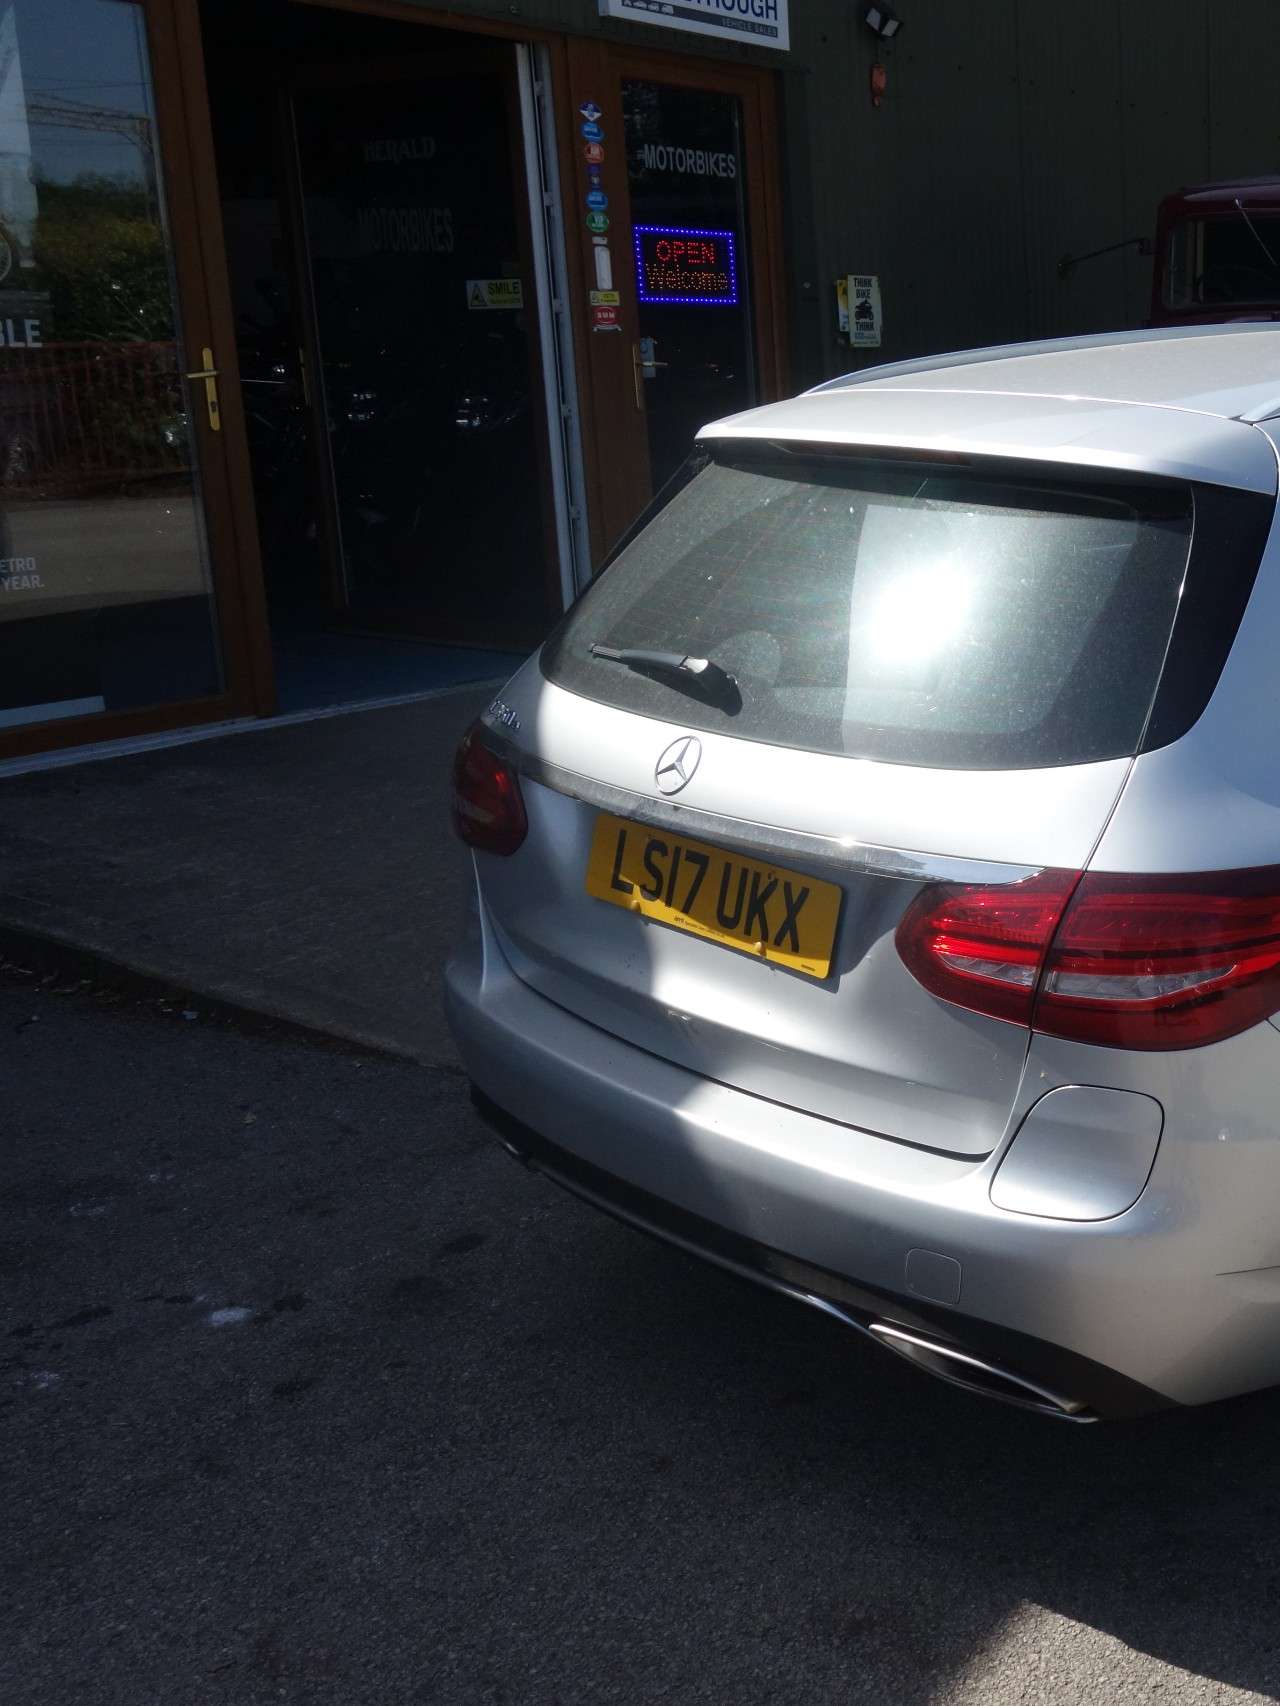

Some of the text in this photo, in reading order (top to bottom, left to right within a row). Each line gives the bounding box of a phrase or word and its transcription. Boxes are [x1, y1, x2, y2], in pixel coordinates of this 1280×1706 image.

[720, 17, 777, 36] VEHICLE SALES
[363, 136, 437, 162] HERALD
[643, 143, 736, 178] MOTORBIKES
[357, 207, 455, 252] MOTORBIKES
[655, 239, 716, 266] OPEN
[487, 281, 521, 297] SMILE
[853, 277, 873, 288] THINK
[855, 289, 871, 299] BIKE
[855, 321, 875, 332] THINK
[610, 829, 810, 953] LS17 UKX
